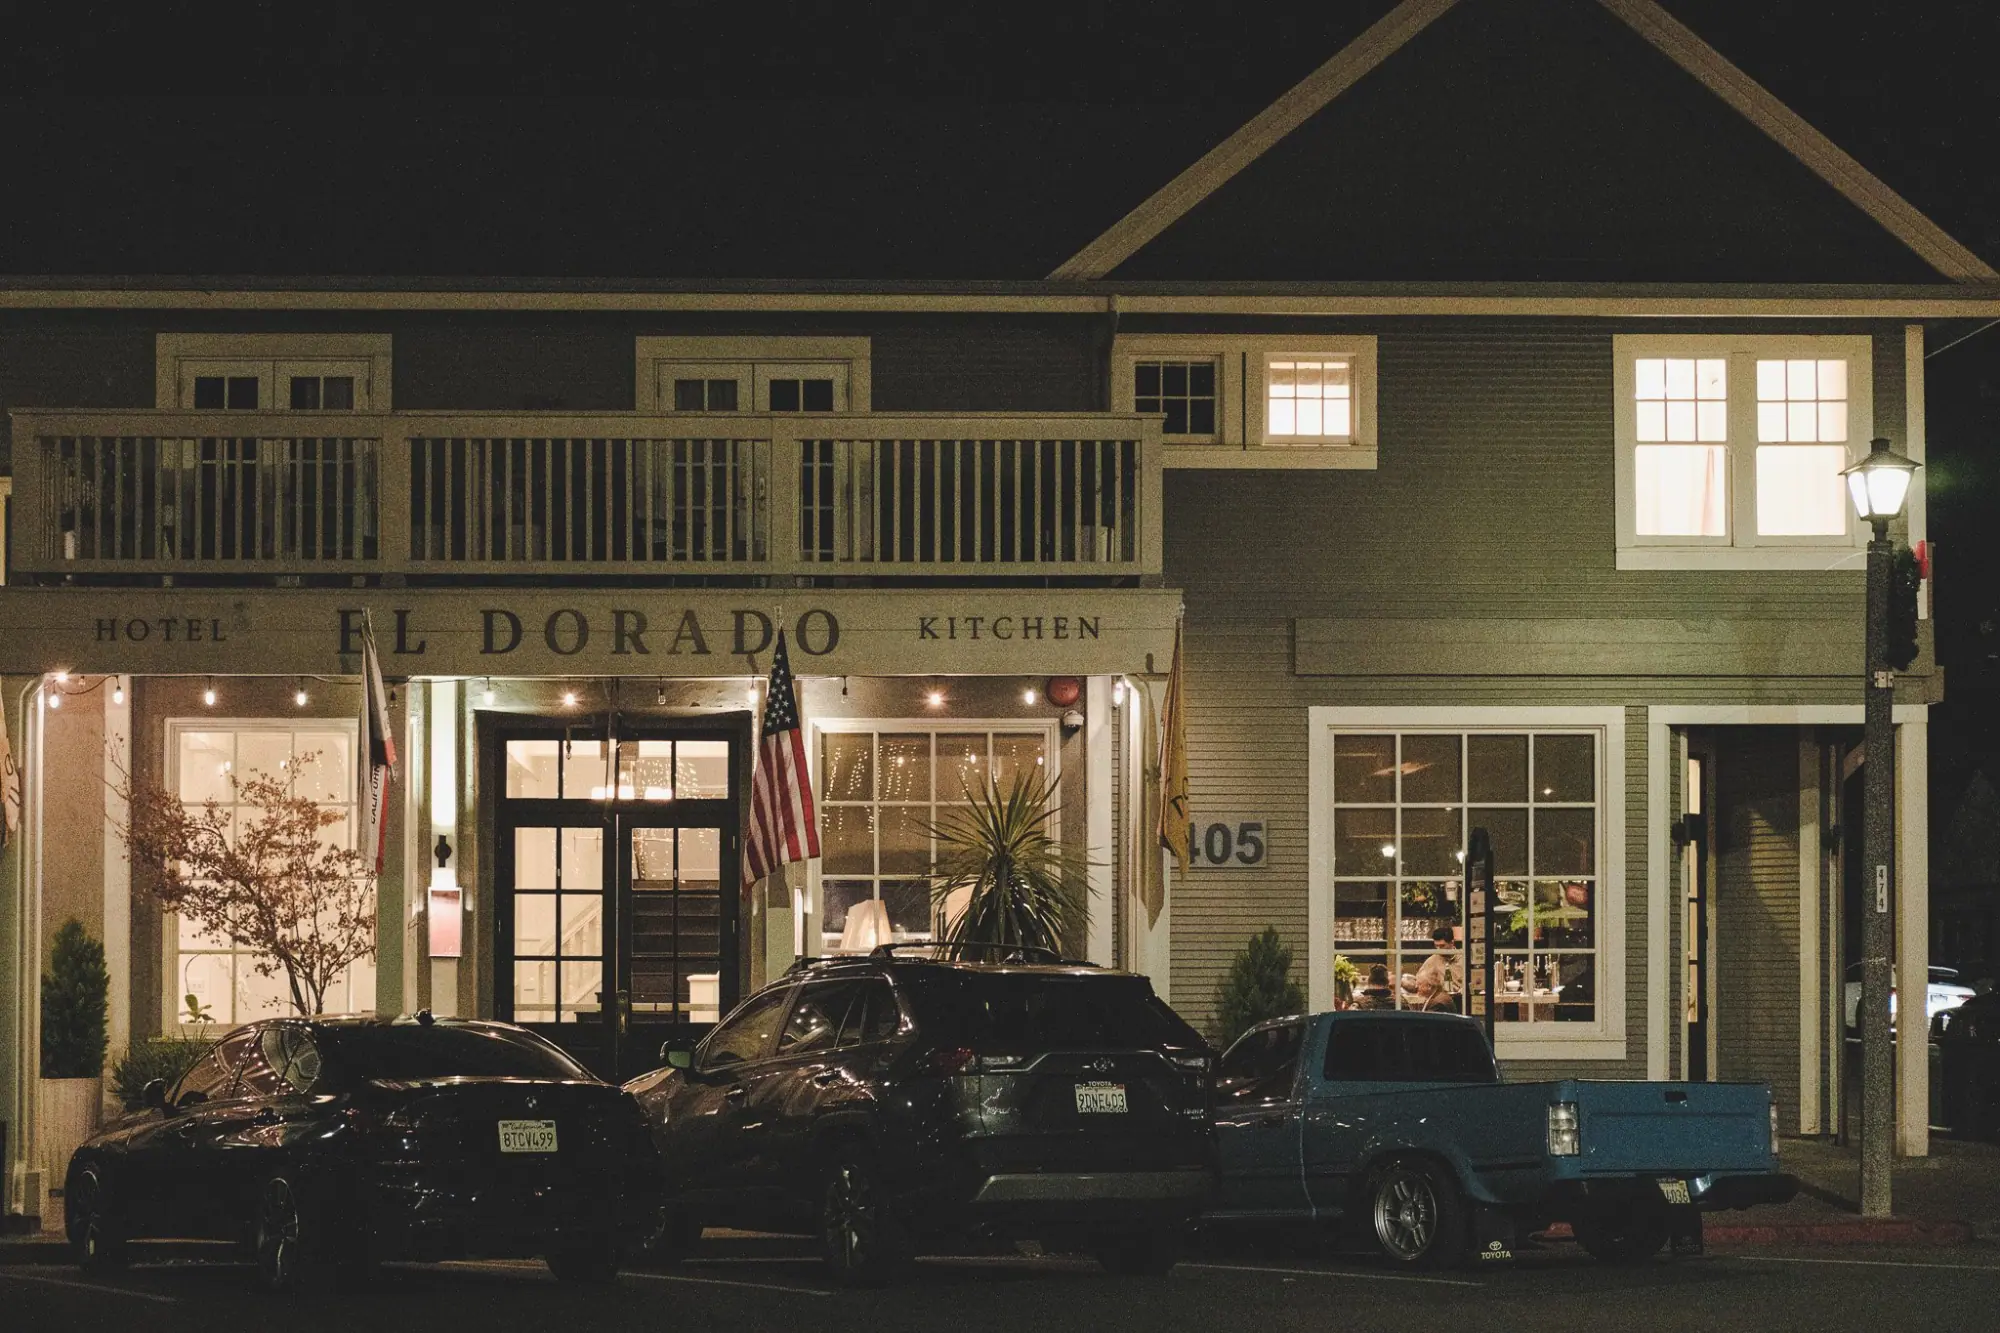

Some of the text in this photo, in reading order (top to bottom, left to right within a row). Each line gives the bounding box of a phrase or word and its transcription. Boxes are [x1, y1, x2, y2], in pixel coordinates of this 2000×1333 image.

[95, 617, 228, 642] HOTEL
[337, 608, 840, 656] EL DORADO
[918, 615, 1102, 640] KITCHEN
[503, 1132, 554, 1147] 8TCV499
[1480, 1250, 1512, 1260] TOYOTA
